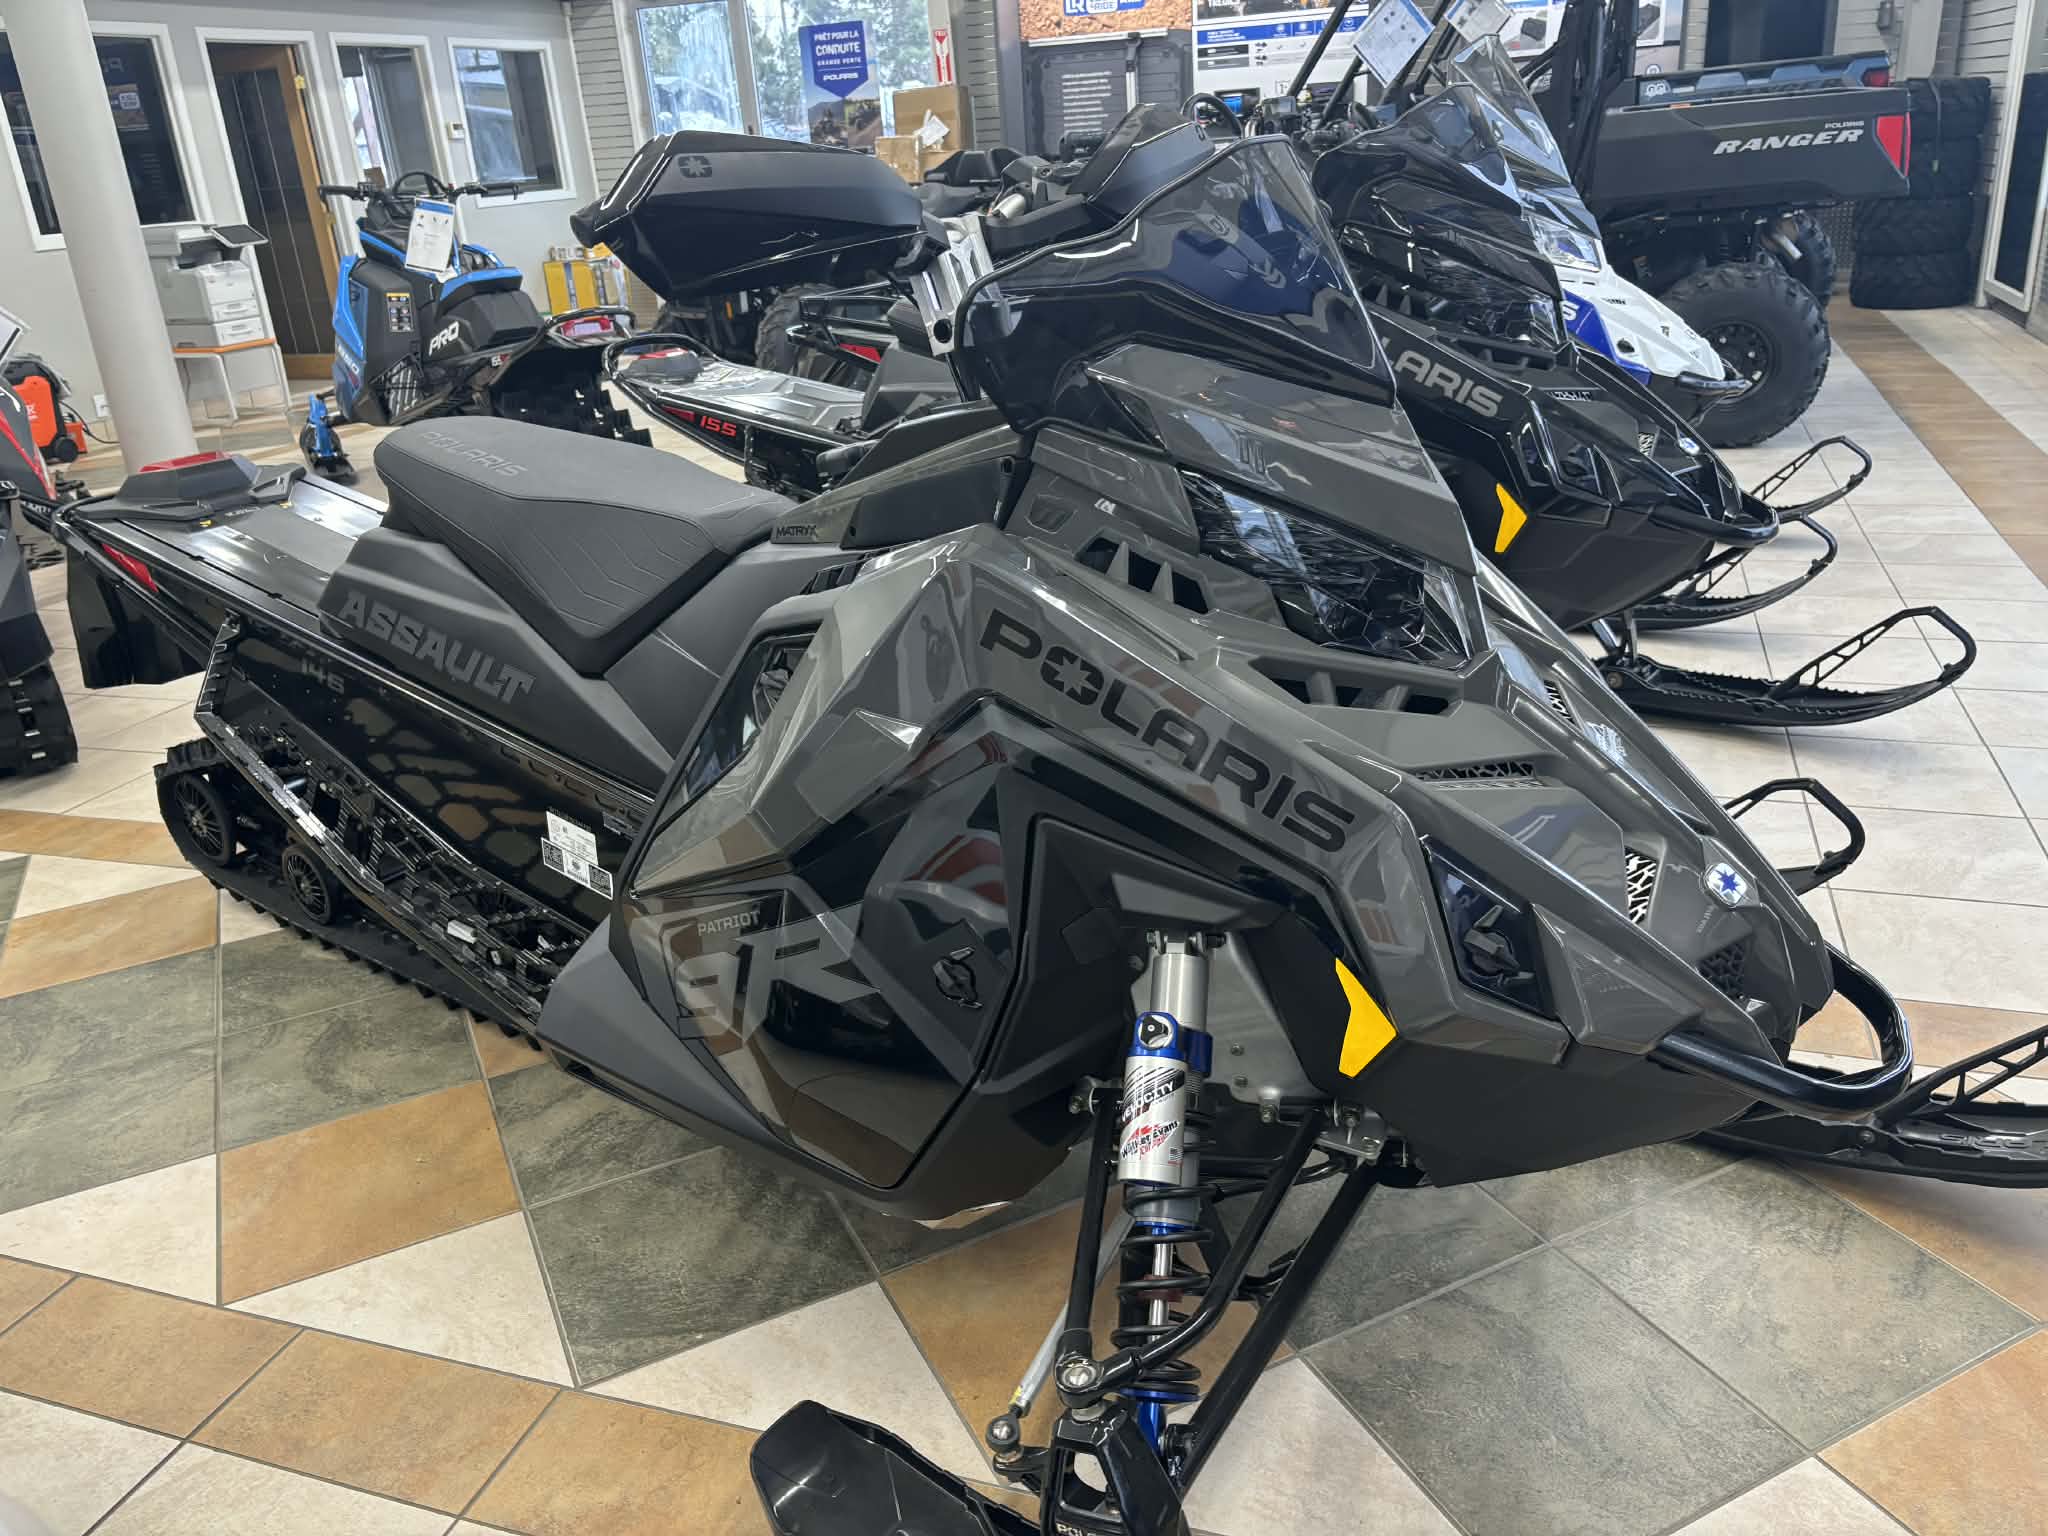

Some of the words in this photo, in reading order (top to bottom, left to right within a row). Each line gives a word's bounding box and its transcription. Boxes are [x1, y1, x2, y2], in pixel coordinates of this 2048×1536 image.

[849, 30, 859, 38] LA
[815, 41, 861, 57] CONDUITE
[823, 72, 859, 81] POLARIS
[1825, 120, 1865, 129] POLARIS
[1713, 129, 1864, 155] RANGER
[429, 321, 460, 357] PRO
[701, 416, 737, 437] 155
[419, 431, 528, 477] POLARIS
[337, 592, 537, 703] ASSAULT
[979, 608, 1357, 854] POLARIS
[696, 910, 761, 937] PATRIOT
[1121, 1080, 1175, 1123] VELOCITY
